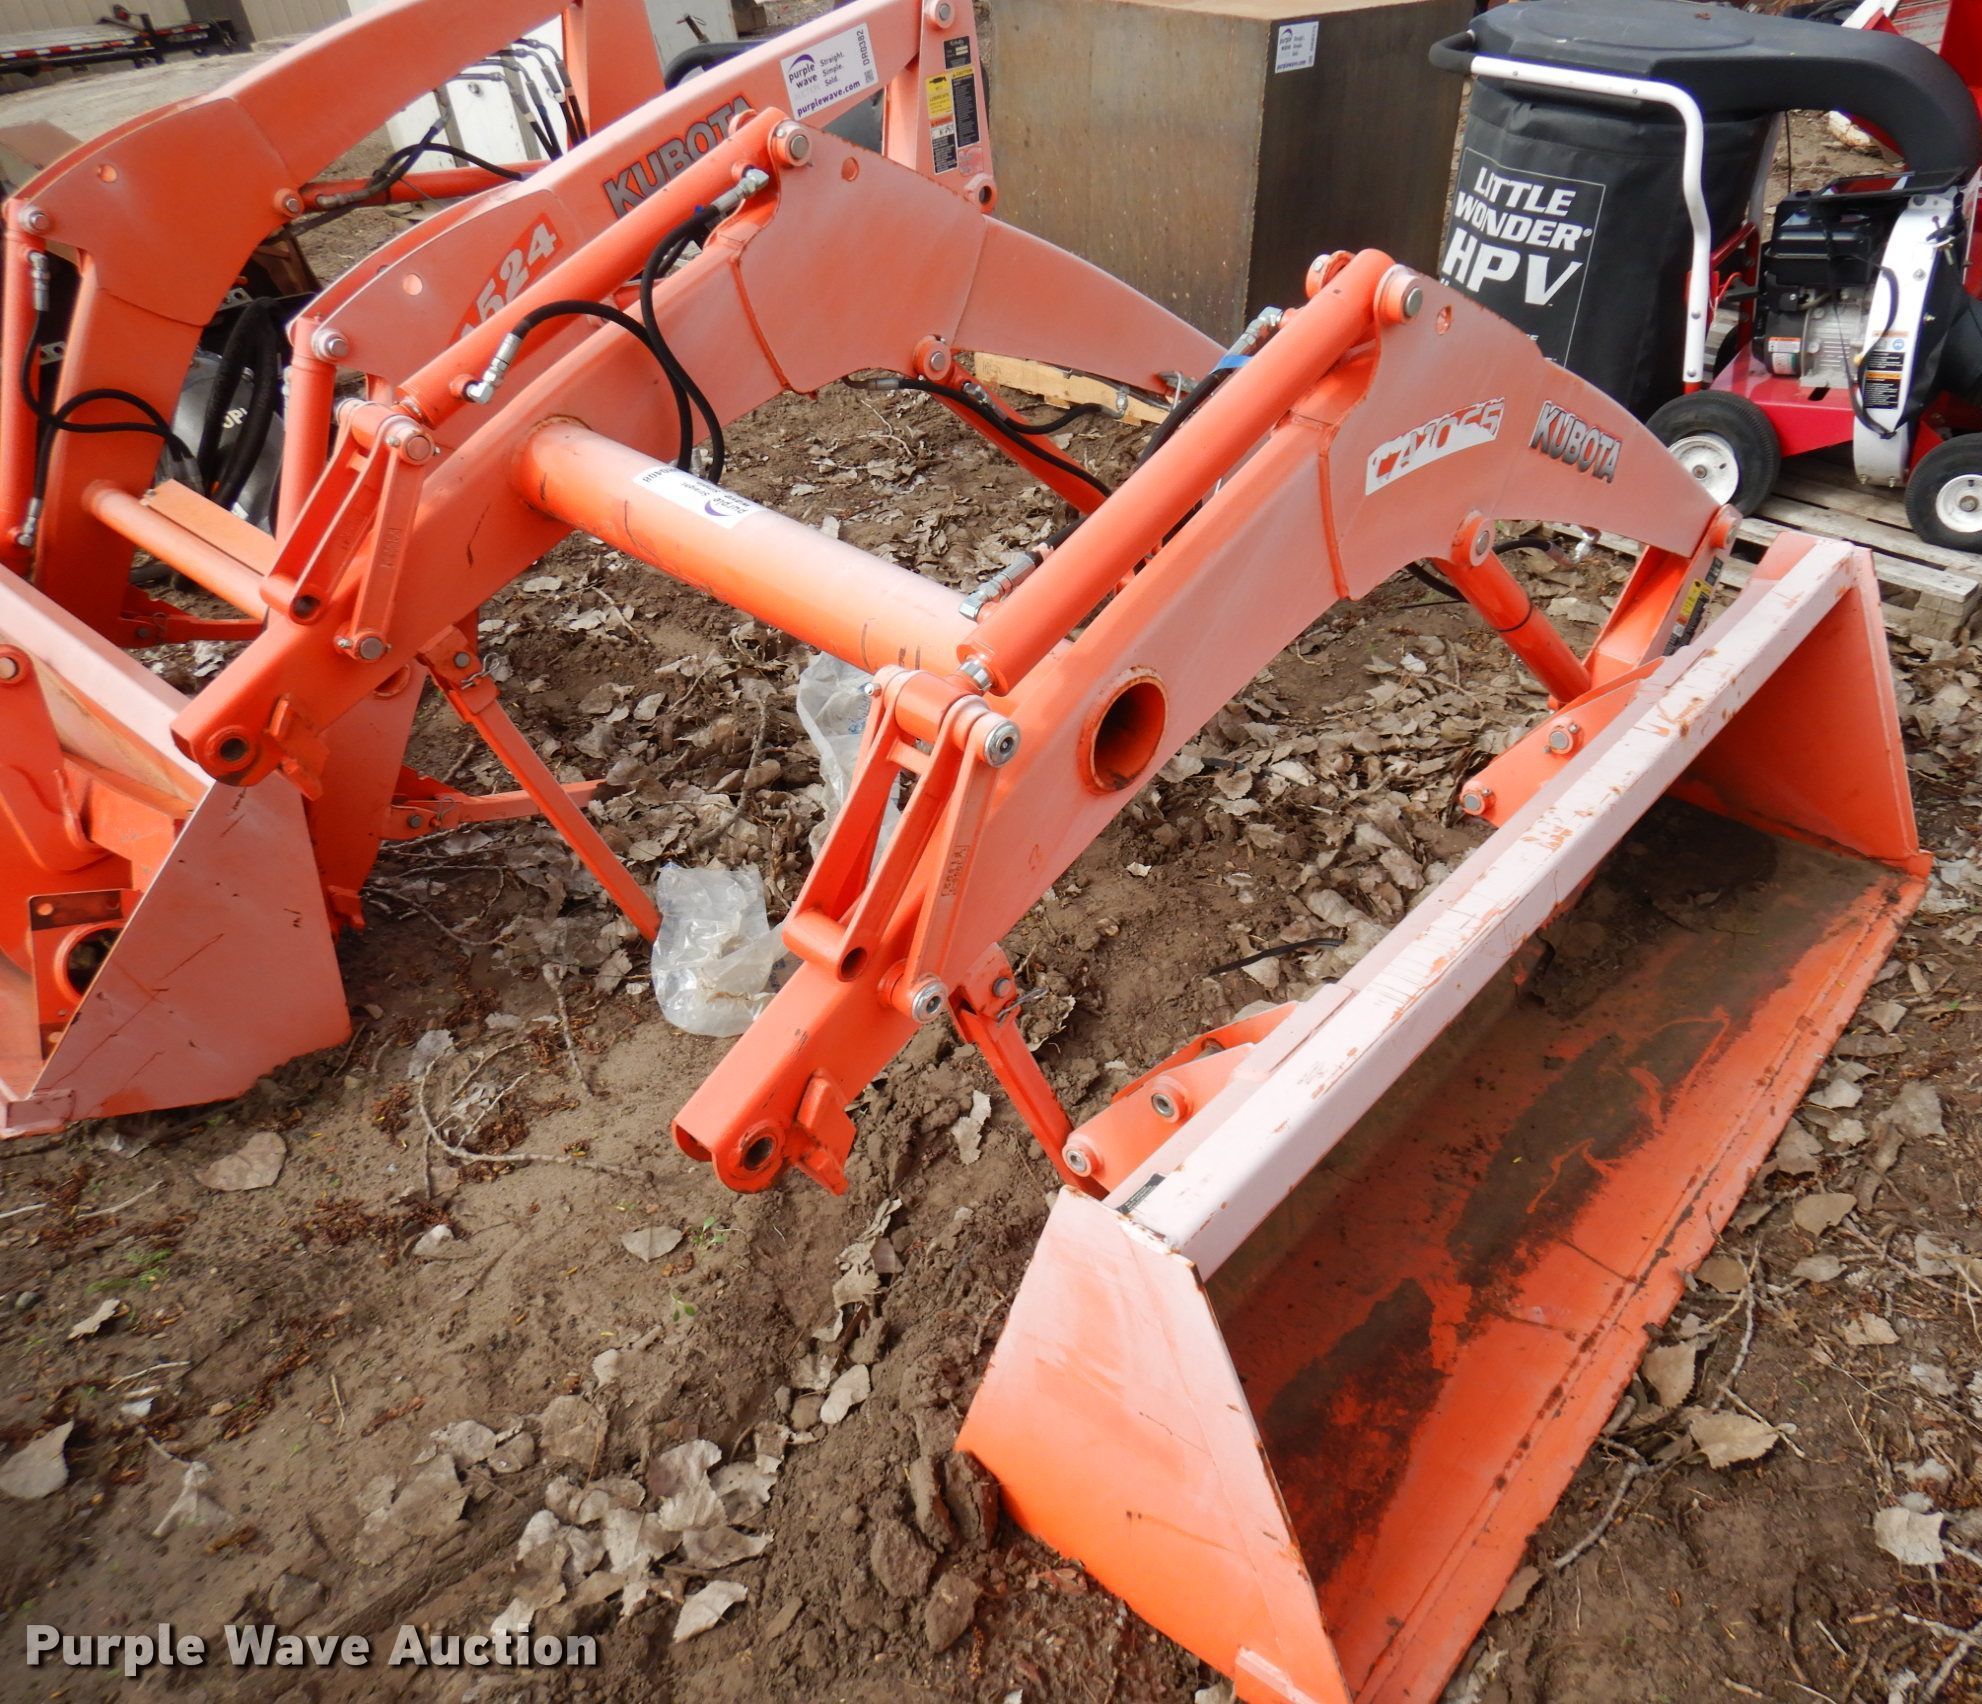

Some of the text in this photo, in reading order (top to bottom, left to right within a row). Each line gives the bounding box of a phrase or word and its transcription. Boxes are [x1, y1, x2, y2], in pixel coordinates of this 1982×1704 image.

[788, 63, 816, 84] purple
[796, 73, 817, 89] wave
[797, 80, 861, 117] purplewave.com
[1474, 166, 1576, 217] LITTLE
[1442, 227, 1583, 306] HPV
[1529, 400, 1622, 483] KUBOTA
